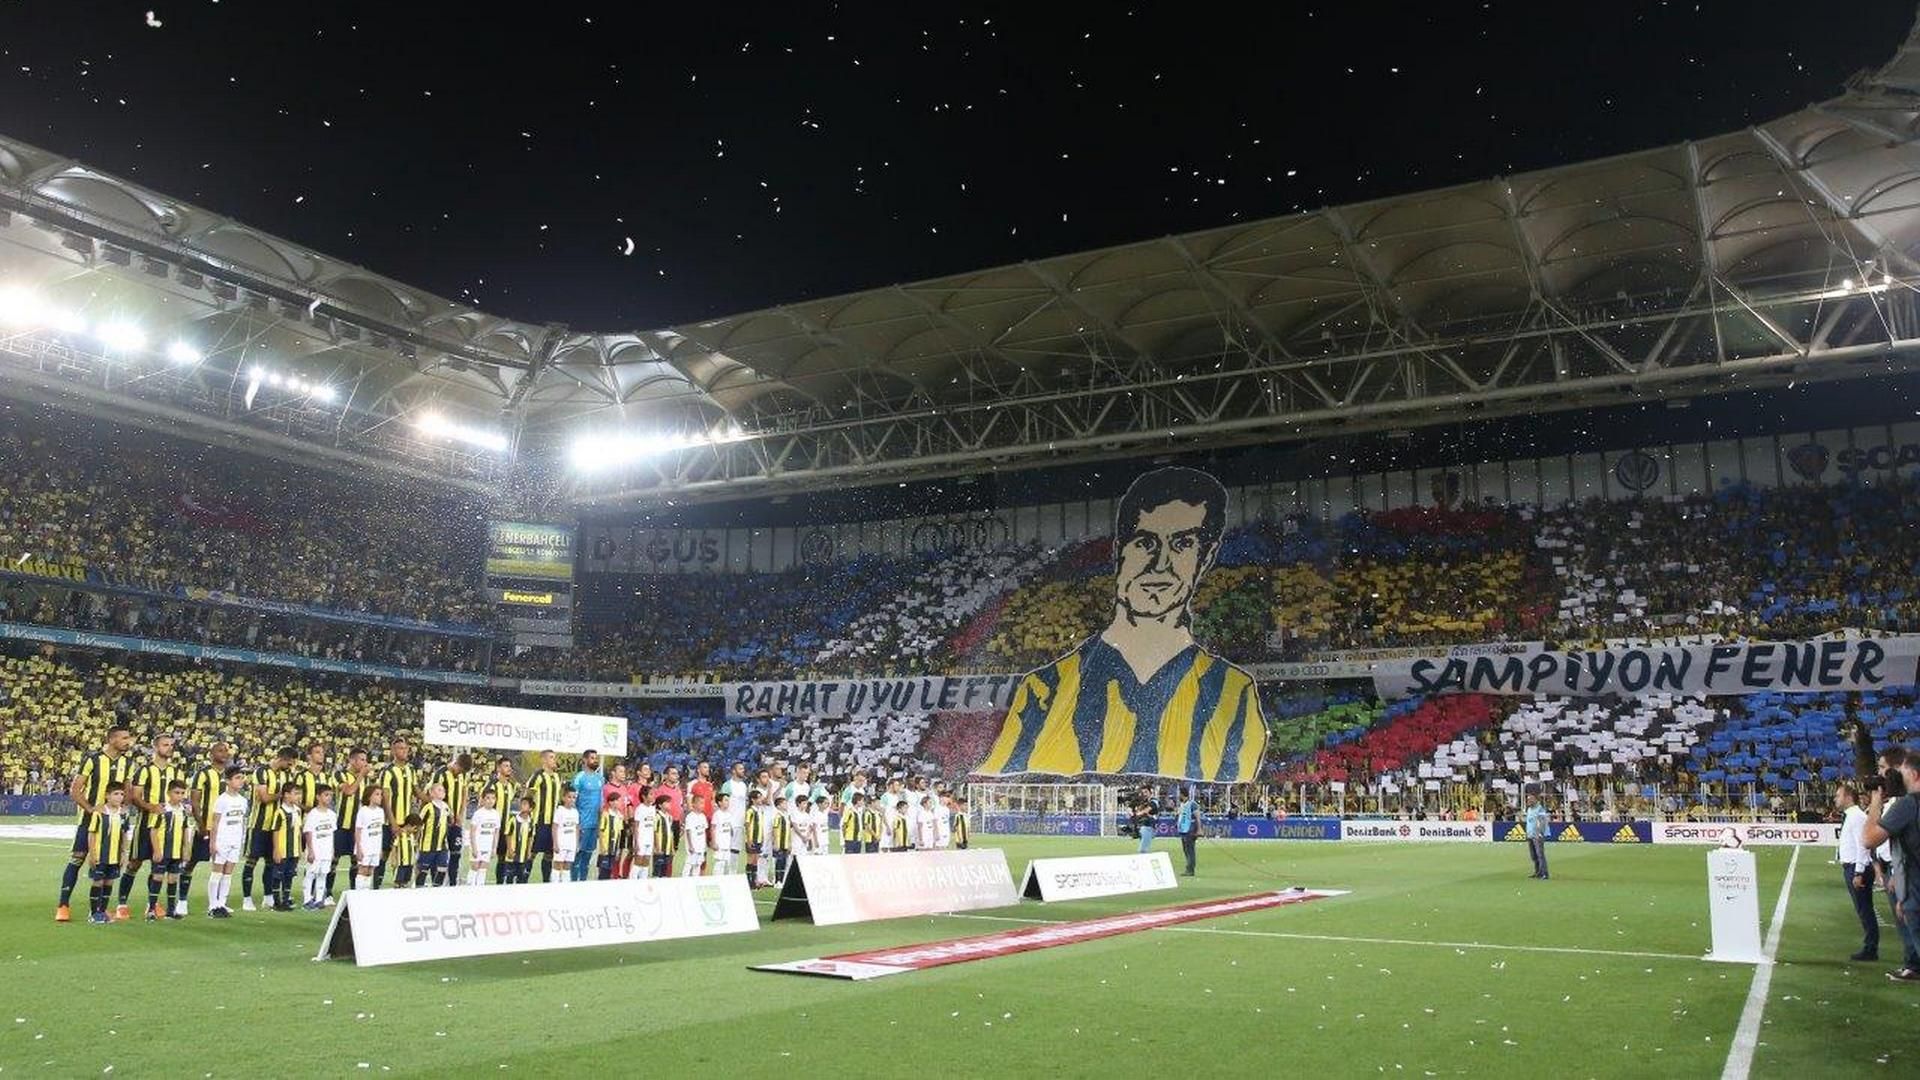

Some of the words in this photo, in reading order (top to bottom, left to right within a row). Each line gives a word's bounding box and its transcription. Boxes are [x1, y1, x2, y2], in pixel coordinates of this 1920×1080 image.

[503, 592, 552, 604] Fenercell
[1704, 640, 1885, 688] FENER
[735, 682, 839, 713] RAHAT
[439, 720, 513, 738] SPORTOTO
[1346, 826, 1397, 838] DenizBank
[1420, 826, 1471, 838] DenizBank
[1747, 829, 1820, 840] SPORTOTO
[402, 911, 544, 943] SPORTOTO
[549, 906, 636, 938] SüperLig
